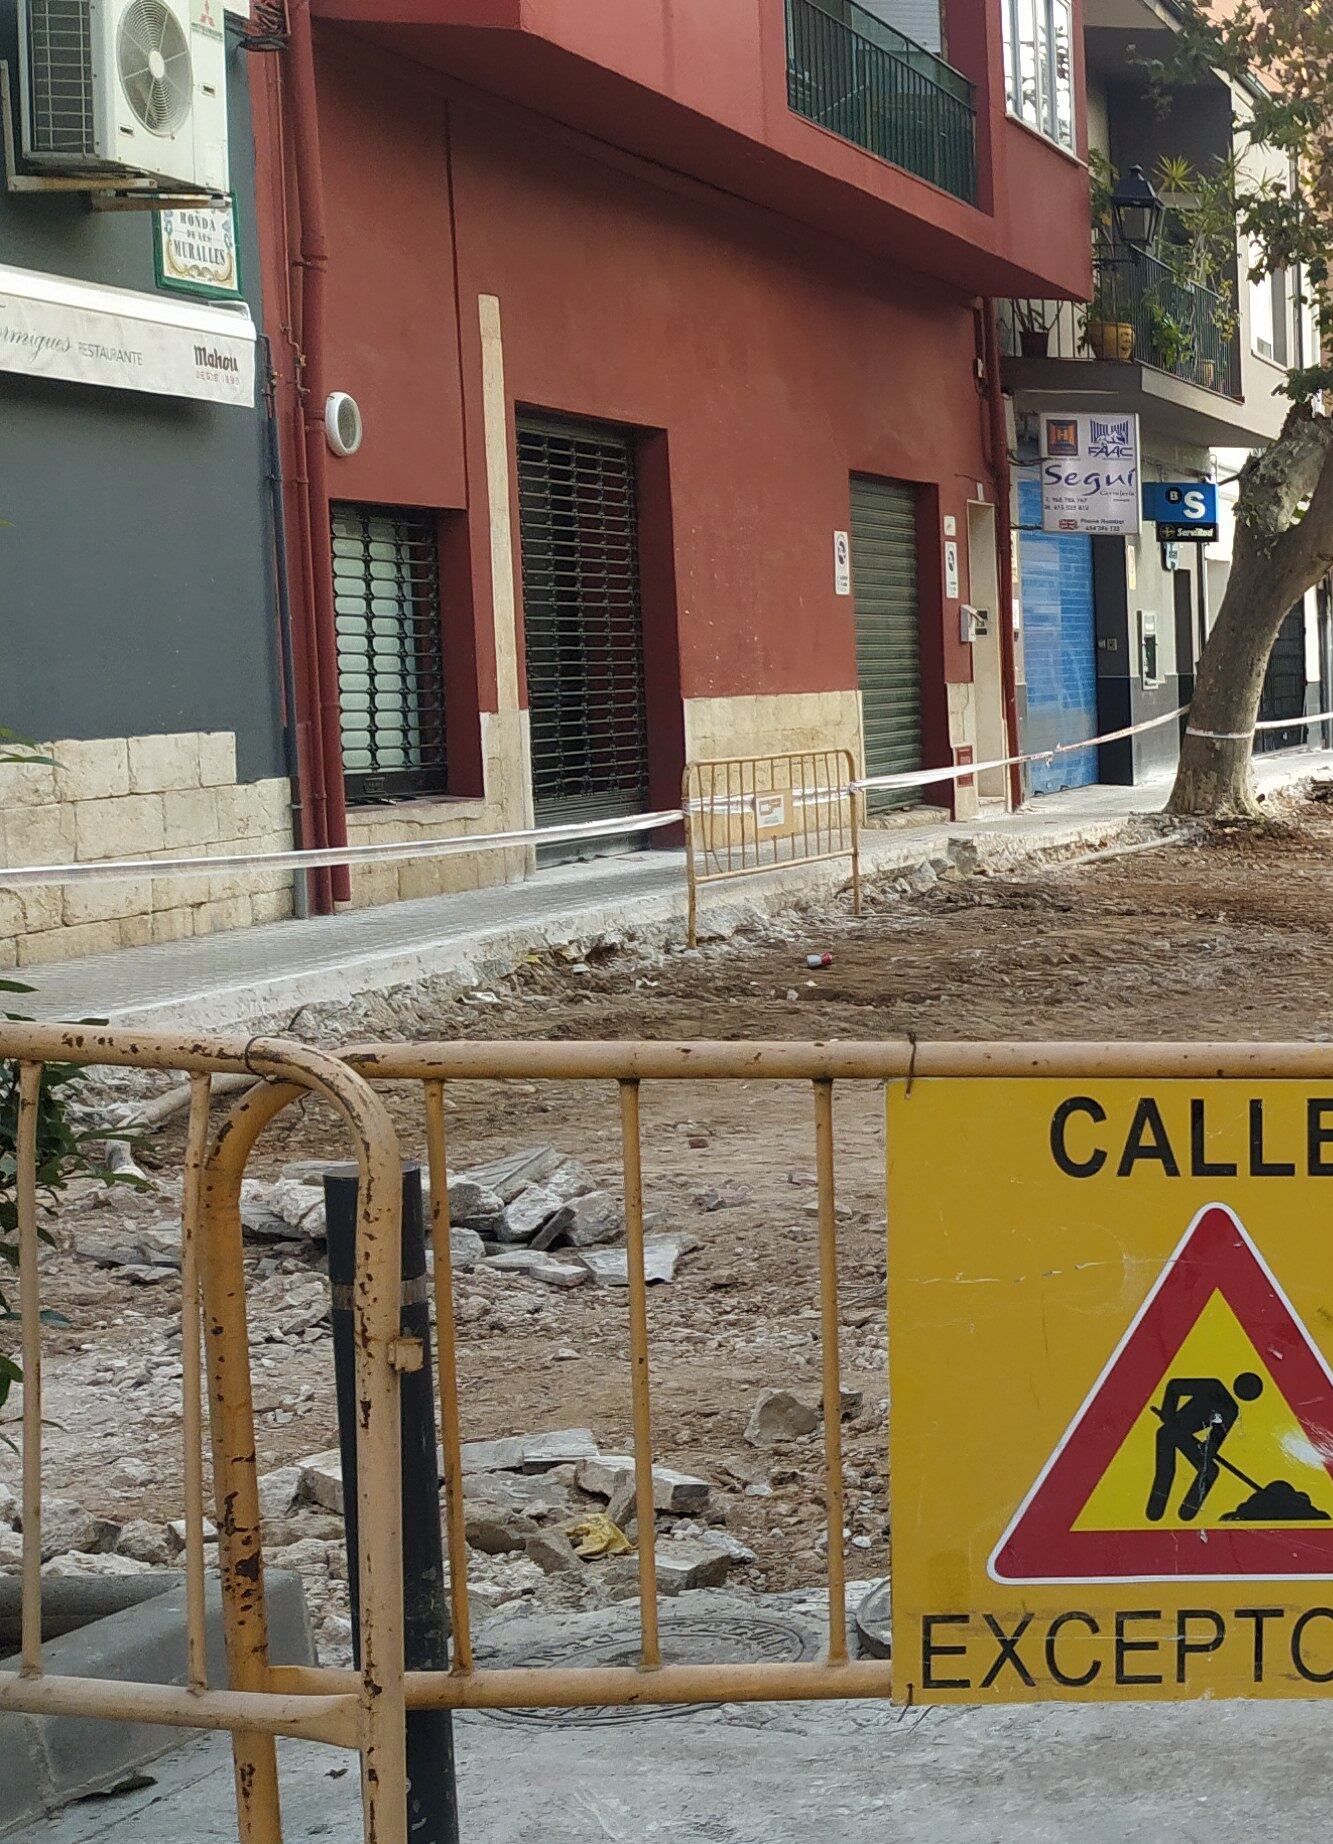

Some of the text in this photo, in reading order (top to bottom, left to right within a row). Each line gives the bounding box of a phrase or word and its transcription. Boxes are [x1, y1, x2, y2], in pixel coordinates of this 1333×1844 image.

[180, 211, 216, 232] RONDA
[174, 239, 226, 267] MURALLES
[78, 341, 144, 367] RESTAURANTE
[193, 344, 239, 372] Mahou
[1088, 446, 1134, 458] FAAC
[1182, 491, 1206, 519] S
